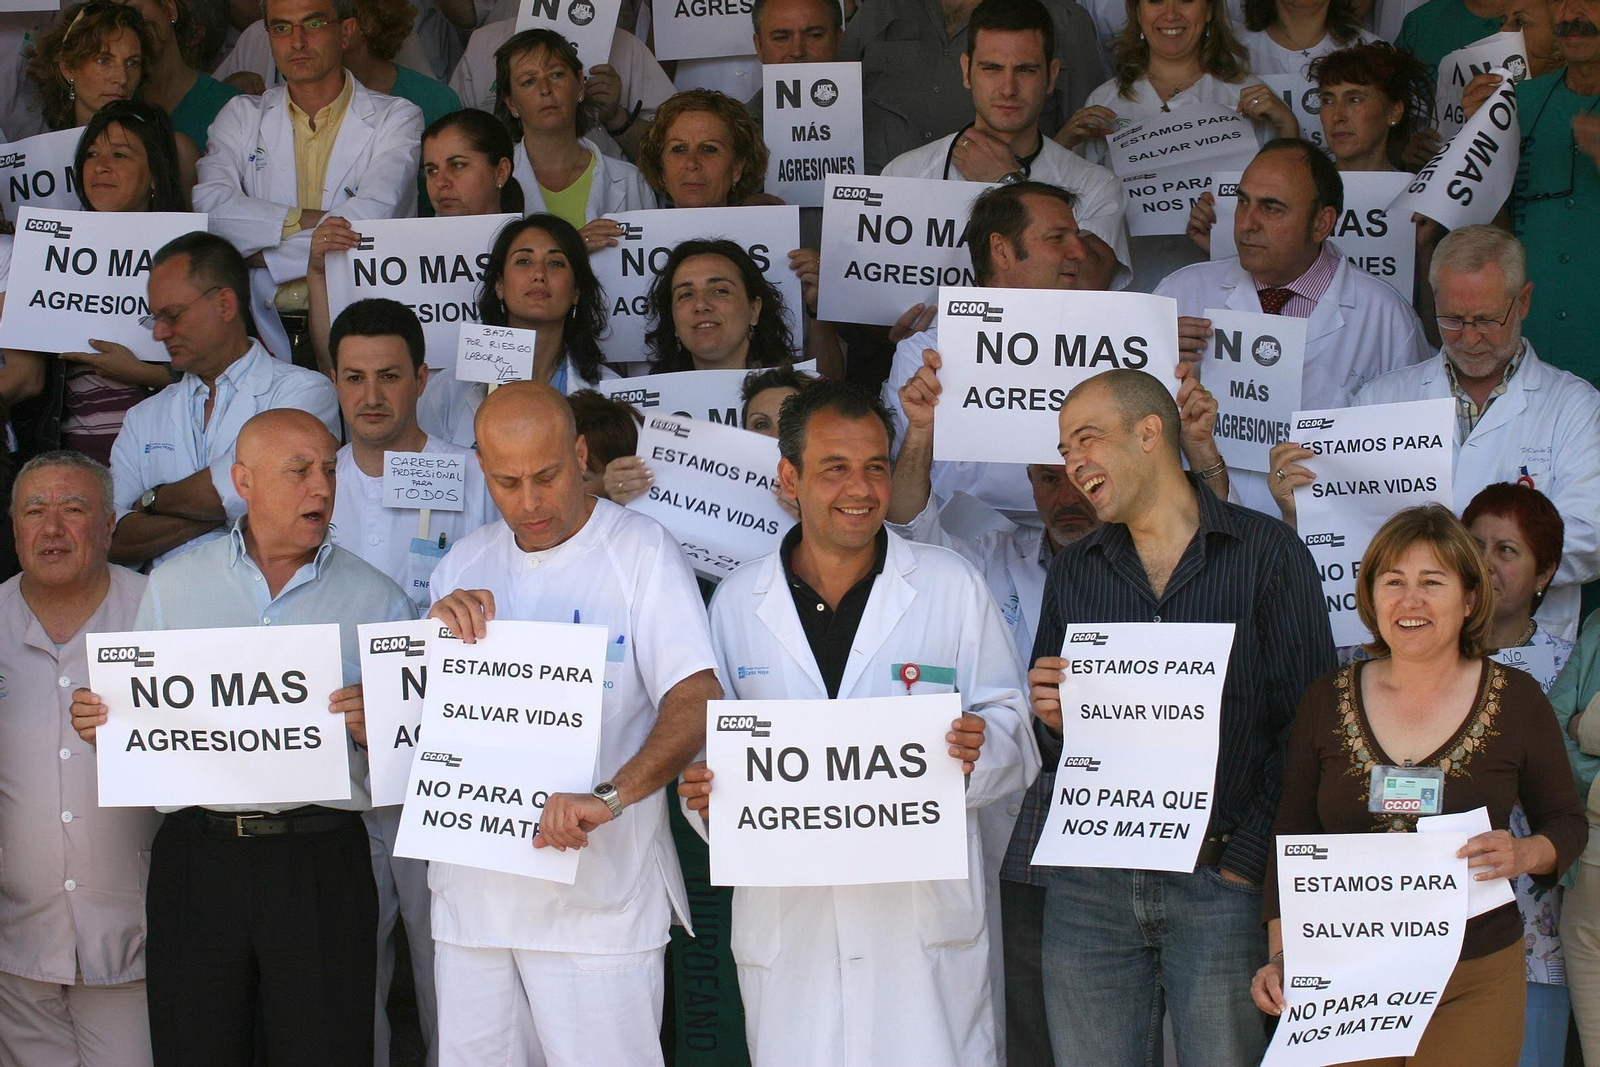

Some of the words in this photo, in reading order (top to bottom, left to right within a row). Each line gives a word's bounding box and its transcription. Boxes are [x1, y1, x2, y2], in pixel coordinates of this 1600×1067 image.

[674, 0, 754, 18] AGRES
[791, 122, 831, 142] MÁS
[1120, 122, 1193, 149] ESTAMOS
[1197, 115, 1242, 127] PARA
[1128, 142, 1191, 163] SALVAR
[1194, 131, 1242, 147] VIDAS
[778, 156, 855, 182] AGRESIONES
[9, 170, 56, 203] NO
[1128, 185, 1157, 198] NO
[1142, 198, 1184, 214] NOS
[857, 213, 913, 245] NO
[1330, 208, 1388, 238] AS
[45, 245, 98, 276] NO
[108, 249, 152, 277] MA
[353, 256, 408, 287] NO
[844, 261, 976, 287] AGRESION
[29, 289, 151, 316] AGRESION
[482, 328, 514, 338] BAJA
[976, 331, 1039, 366] NO
[1054, 334, 1149, 370] MAS
[963, 386, 1065, 412] AGRES
[1230, 379, 1269, 402] MÁS
[1213, 412, 1291, 446] AGRESIONES
[1300, 437, 1387, 456] ESTAMOS
[1392, 434, 1443, 452] PARA
[390, 457, 460, 469] CARRERA
[651, 445, 741, 481] ESTAMOS
[744, 470, 780, 491] PA
[394, 487, 459, 502] TODOS
[1312, 479, 1380, 498] SALVAR
[1384, 476, 1437, 495] VIDAS
[648, 485, 722, 519] SALVAR
[725, 507, 780, 536] VIDAS
[1326, 592, 1357, 613] NO
[1071, 659, 1159, 675] ESTAMOS
[1164, 661, 1216, 675] PARA
[1502, 649, 1522, 663] NO
[442, 658, 533, 680] ESTAMOS
[539, 665, 593, 684] PARA
[131, 675, 195, 709] NO
[211, 670, 309, 708] MAS
[442, 703, 519, 724] SALVAR
[525, 709, 583, 728] VIDAS
[1080, 704, 1147, 720] SALVAR
[1151, 704, 1205, 720] VIDAS
[126, 725, 322, 752] AGRESIONES
[746, 746, 809, 782] NO
[825, 742, 928, 782] MAS
[416, 779, 452, 798] NO
[457, 783, 524, 806] PARA
[1060, 787, 1091, 806] NO
[1097, 788, 1155, 809] PARA
[1162, 790, 1208, 810] QUE
[422, 809, 473, 831] NOS
[480, 815, 541, 840] MAT
[737, 800, 941, 830] AGRESIONES
[1062, 818, 1108, 836] NOS
[1113, 821, 1190, 840] MATEN
[1293, 875, 1393, 893] ESTAMOS
[1400, 874, 1457, 891] PARA
[1302, 921, 1385, 939] SALVAR
[1390, 921, 1449, 938] VIDAS
[1287, 1002, 1317, 1023] NO
[1322, 991, 1379, 1017] PARA
[1386, 991, 1437, 1007] QUE
[1286, 1025, 1332, 1047] NOS
[1335, 1015, 1413, 1038] MATEN
